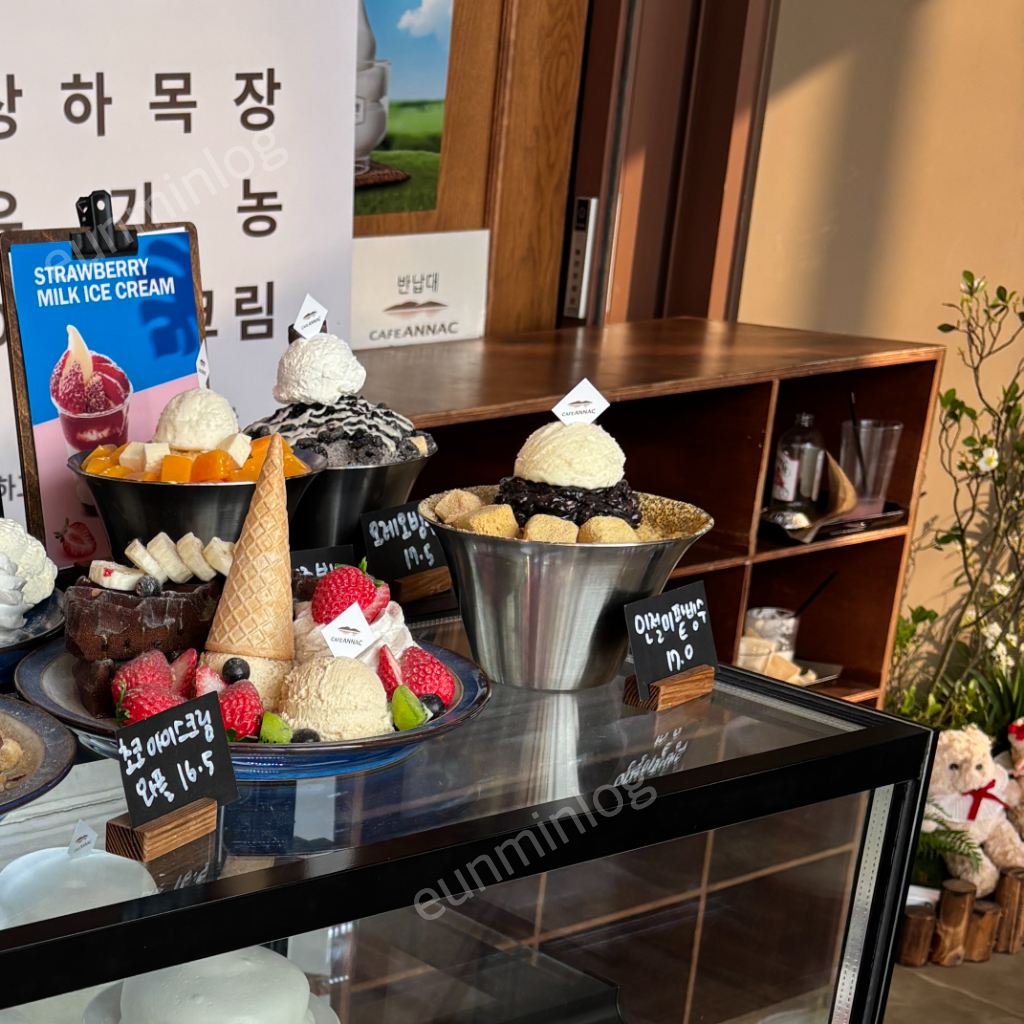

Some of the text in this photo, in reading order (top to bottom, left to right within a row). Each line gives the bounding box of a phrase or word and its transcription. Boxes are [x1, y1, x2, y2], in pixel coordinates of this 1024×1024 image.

[34, 258, 149, 286] STRAWBERRY
[397, 272, 439, 295] 반납대
[37, 277, 175, 307] MILK ICE CREAM
[666, 643, 694, 672] 17.0
[147, 709, 215, 756] 아이스크림
[136, 750, 215, 807] 와플 16.5
